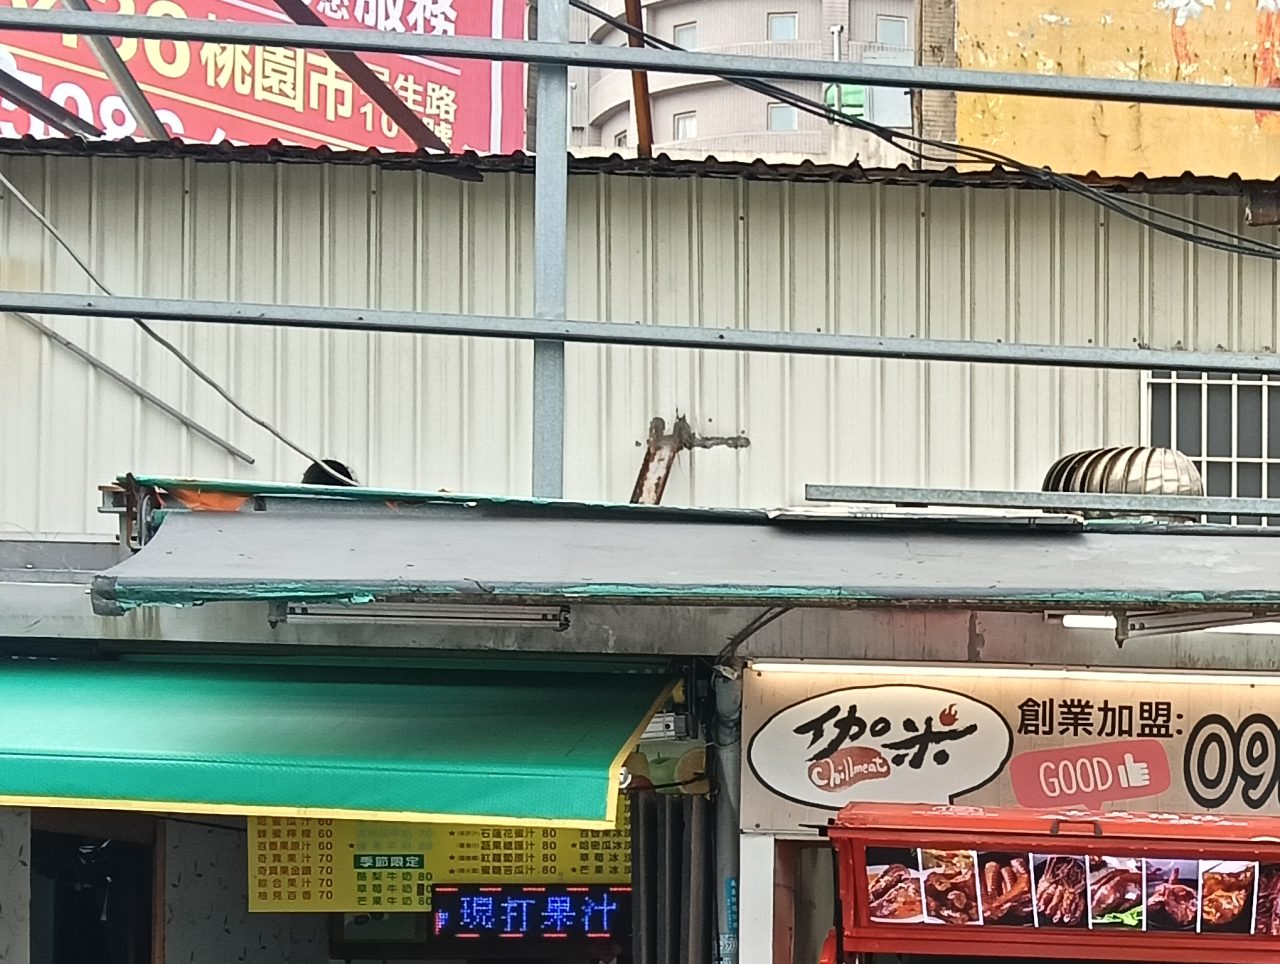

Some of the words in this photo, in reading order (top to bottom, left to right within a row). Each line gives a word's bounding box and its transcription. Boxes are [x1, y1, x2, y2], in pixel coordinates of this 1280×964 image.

[199, 13, 354, 122] 桃園市
[1017, 697, 1184, 738] 創業加盟:
[1039, 754, 1114, 799] GOOD
[318, 829, 333, 839] 60
[542, 827, 557, 838] 80
[318, 841, 333, 851] 60
[542, 840, 557, 850] 80
[318, 853, 333, 863] 70
[359, 855, 420, 868] 季節限定
[318, 865, 333, 876] 70
[417, 871, 433, 882] 80
[318, 878, 333, 888] 70
[318, 891, 333, 901] 70
[460, 893, 618, 931] 現打果汁
